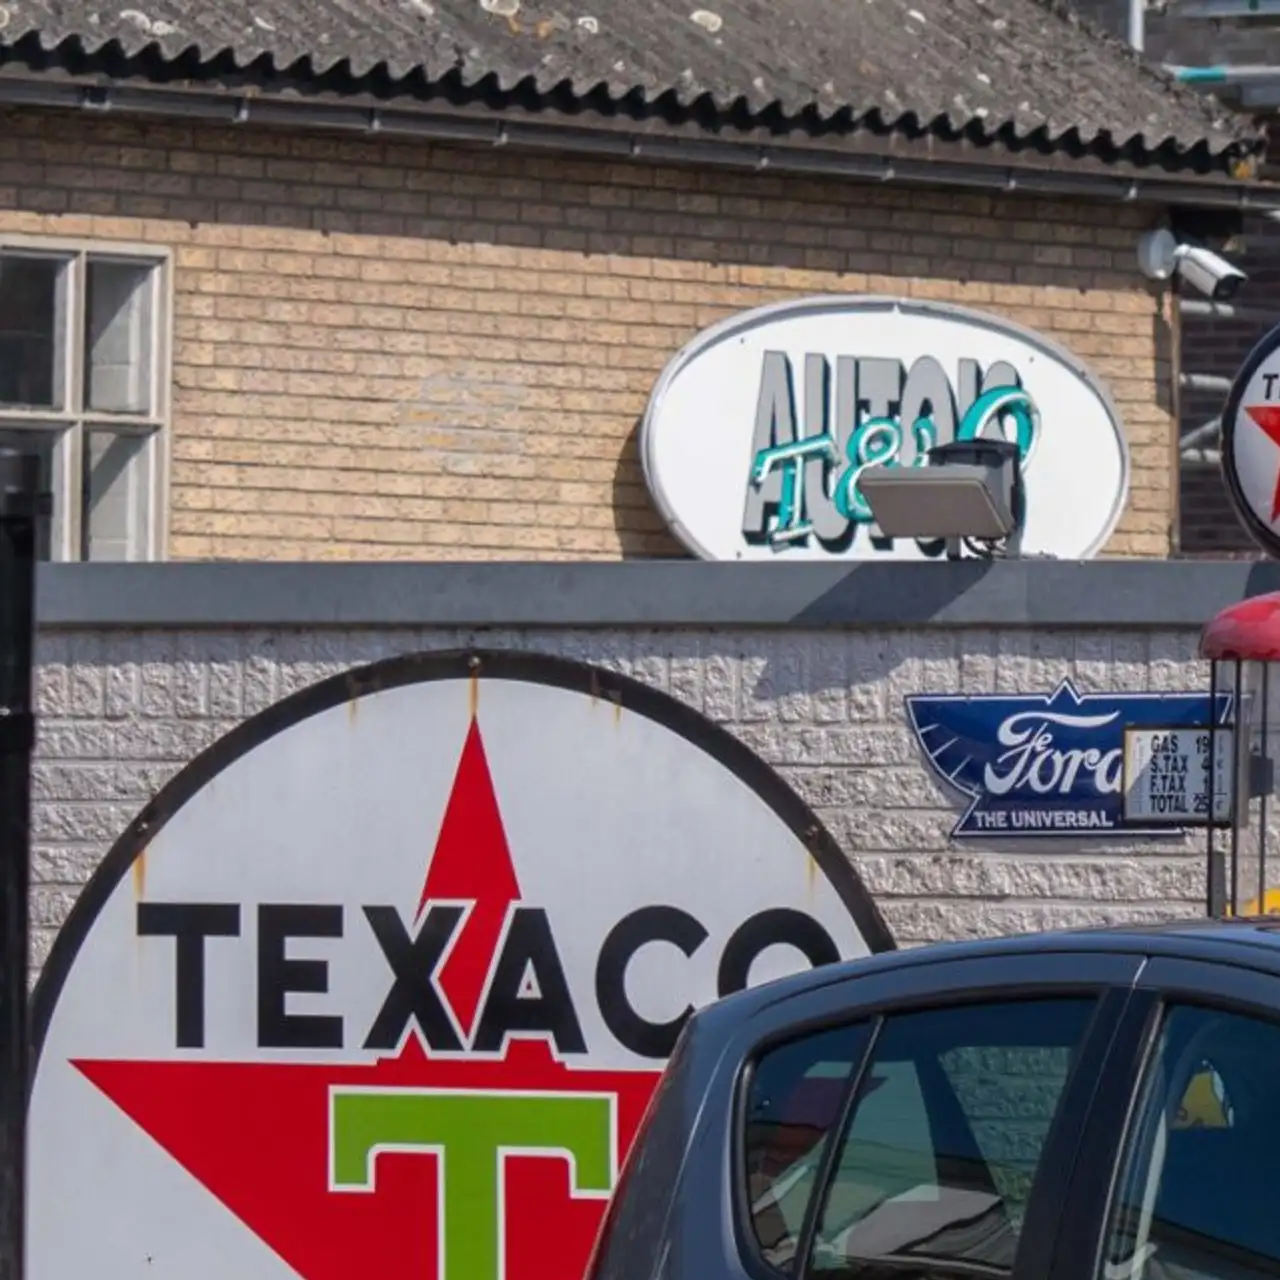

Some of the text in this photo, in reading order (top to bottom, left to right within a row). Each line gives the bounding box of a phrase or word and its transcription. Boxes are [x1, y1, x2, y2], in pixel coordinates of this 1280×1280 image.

[1151, 734, 1179, 754] GAS
[1151, 755, 1189, 773] S.TAX
[1150, 774, 1187, 793] F.TAX
[1150, 794, 1188, 813] TOTAL
[974, 810, 1114, 828] THE UNIVERSAL
